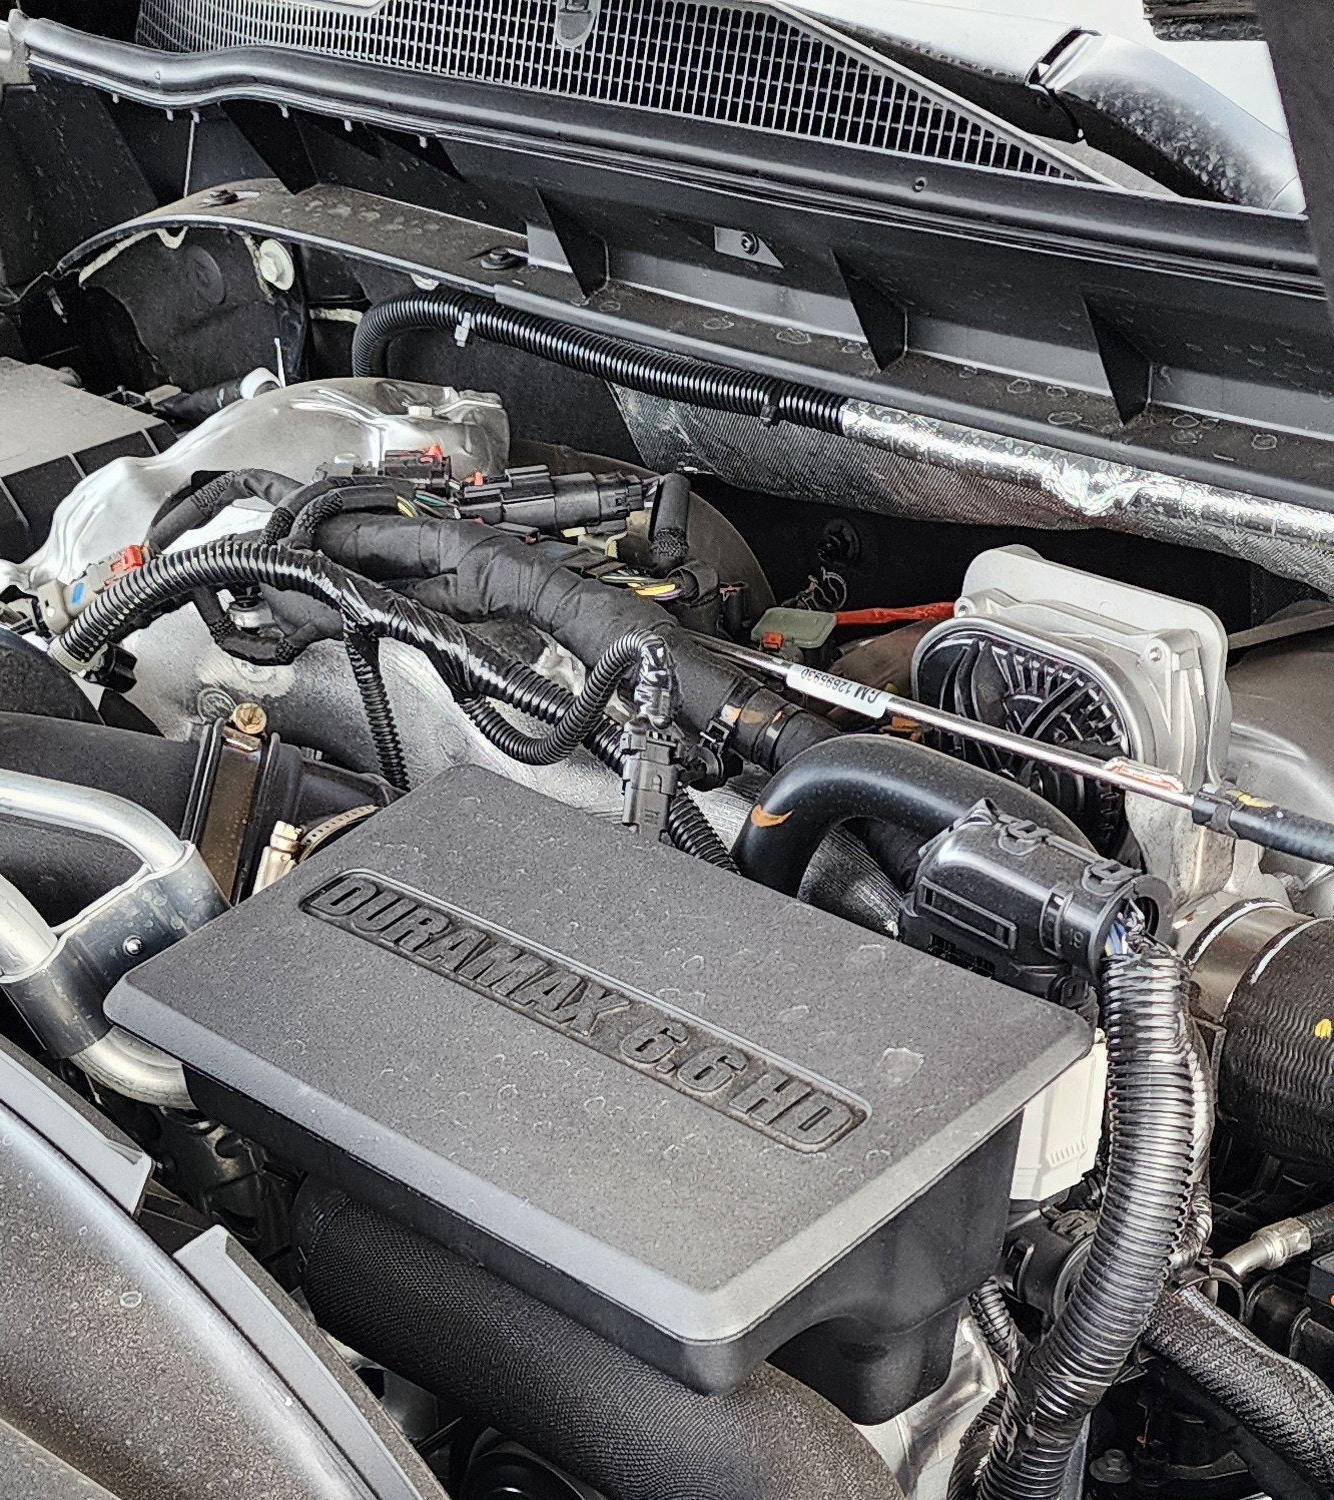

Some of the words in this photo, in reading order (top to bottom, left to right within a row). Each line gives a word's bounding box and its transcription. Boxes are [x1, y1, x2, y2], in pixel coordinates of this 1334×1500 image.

[322, 877, 631, 1037] DURAMAX
[620, 1017, 748, 1094] 6.6
[729, 1070, 859, 1147] HD
